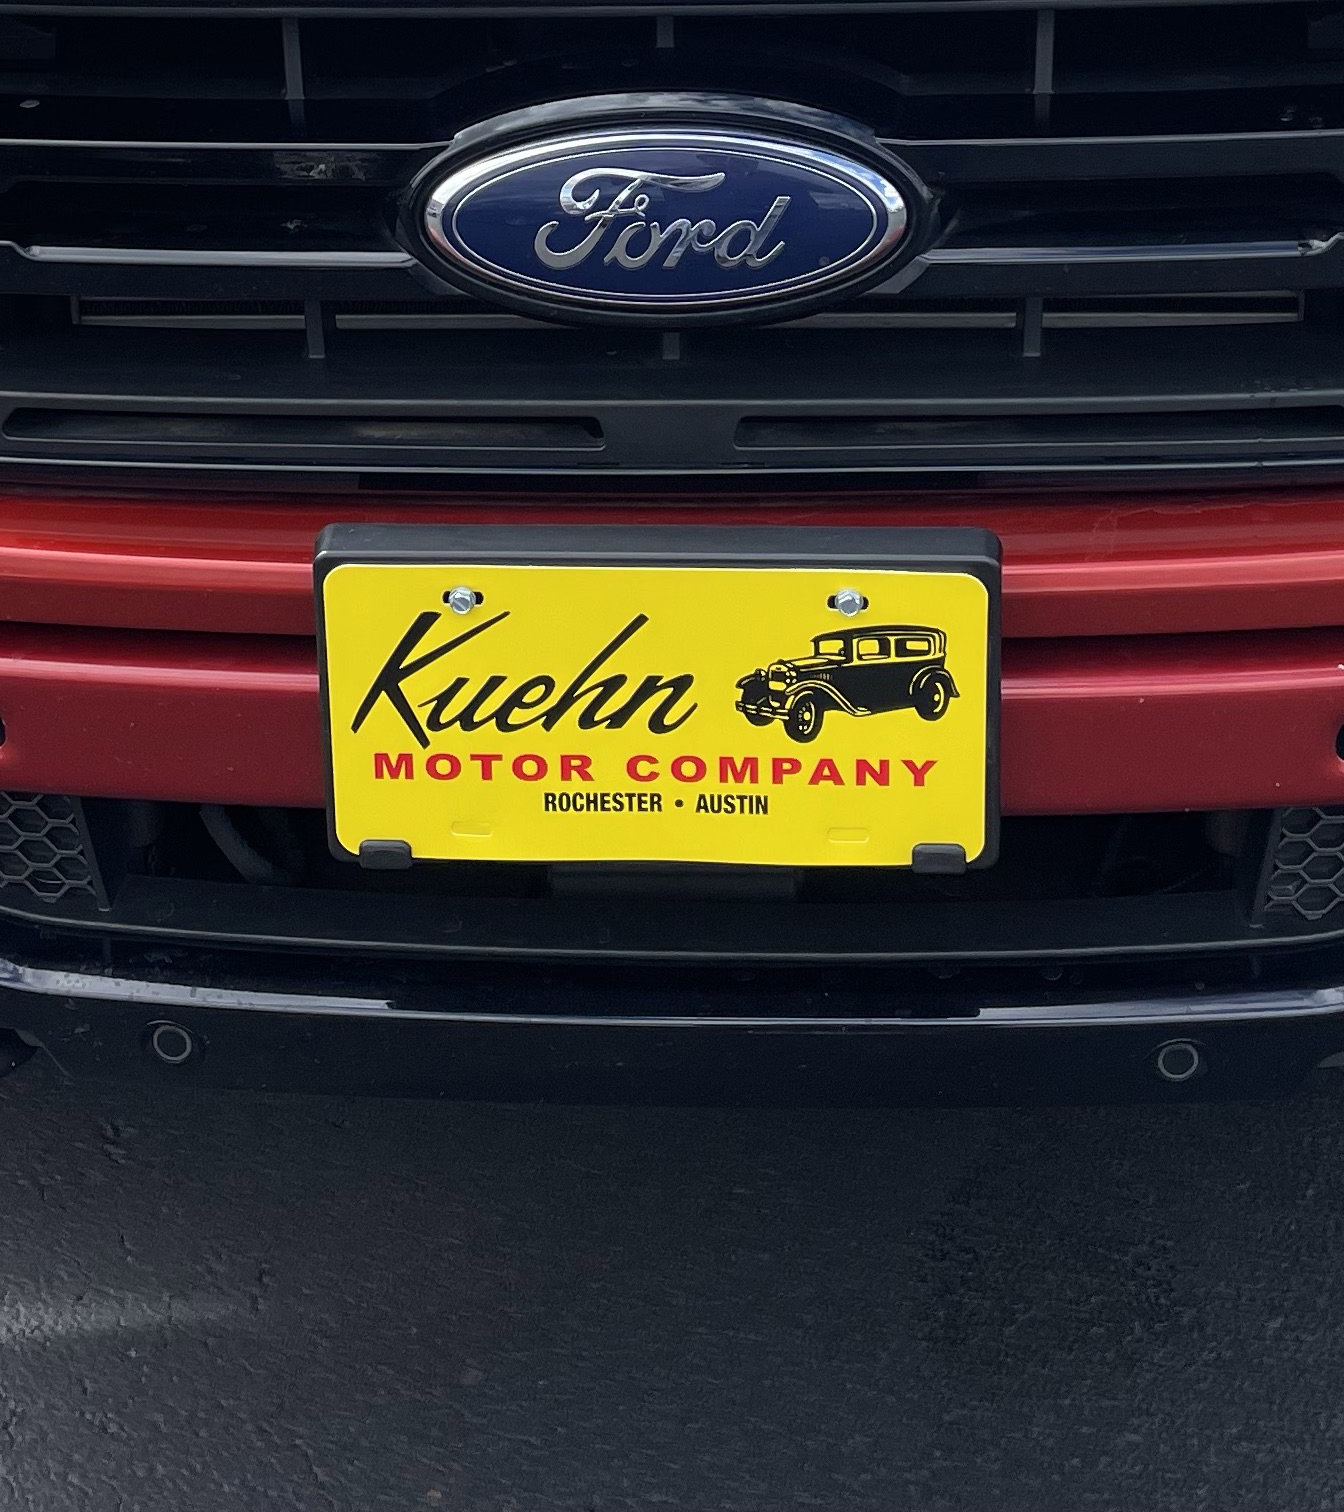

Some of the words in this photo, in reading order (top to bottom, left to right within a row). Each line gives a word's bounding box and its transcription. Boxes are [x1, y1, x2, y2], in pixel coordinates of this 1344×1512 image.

[534, 167, 791, 271] Ford
[350, 609, 698, 749] Kuehn
[372, 752, 594, 783] MOTOR
[624, 754, 939, 787] COMPANY
[543, 792, 663, 814] ROCHESTER
[695, 793, 769, 816] AUSTIN
